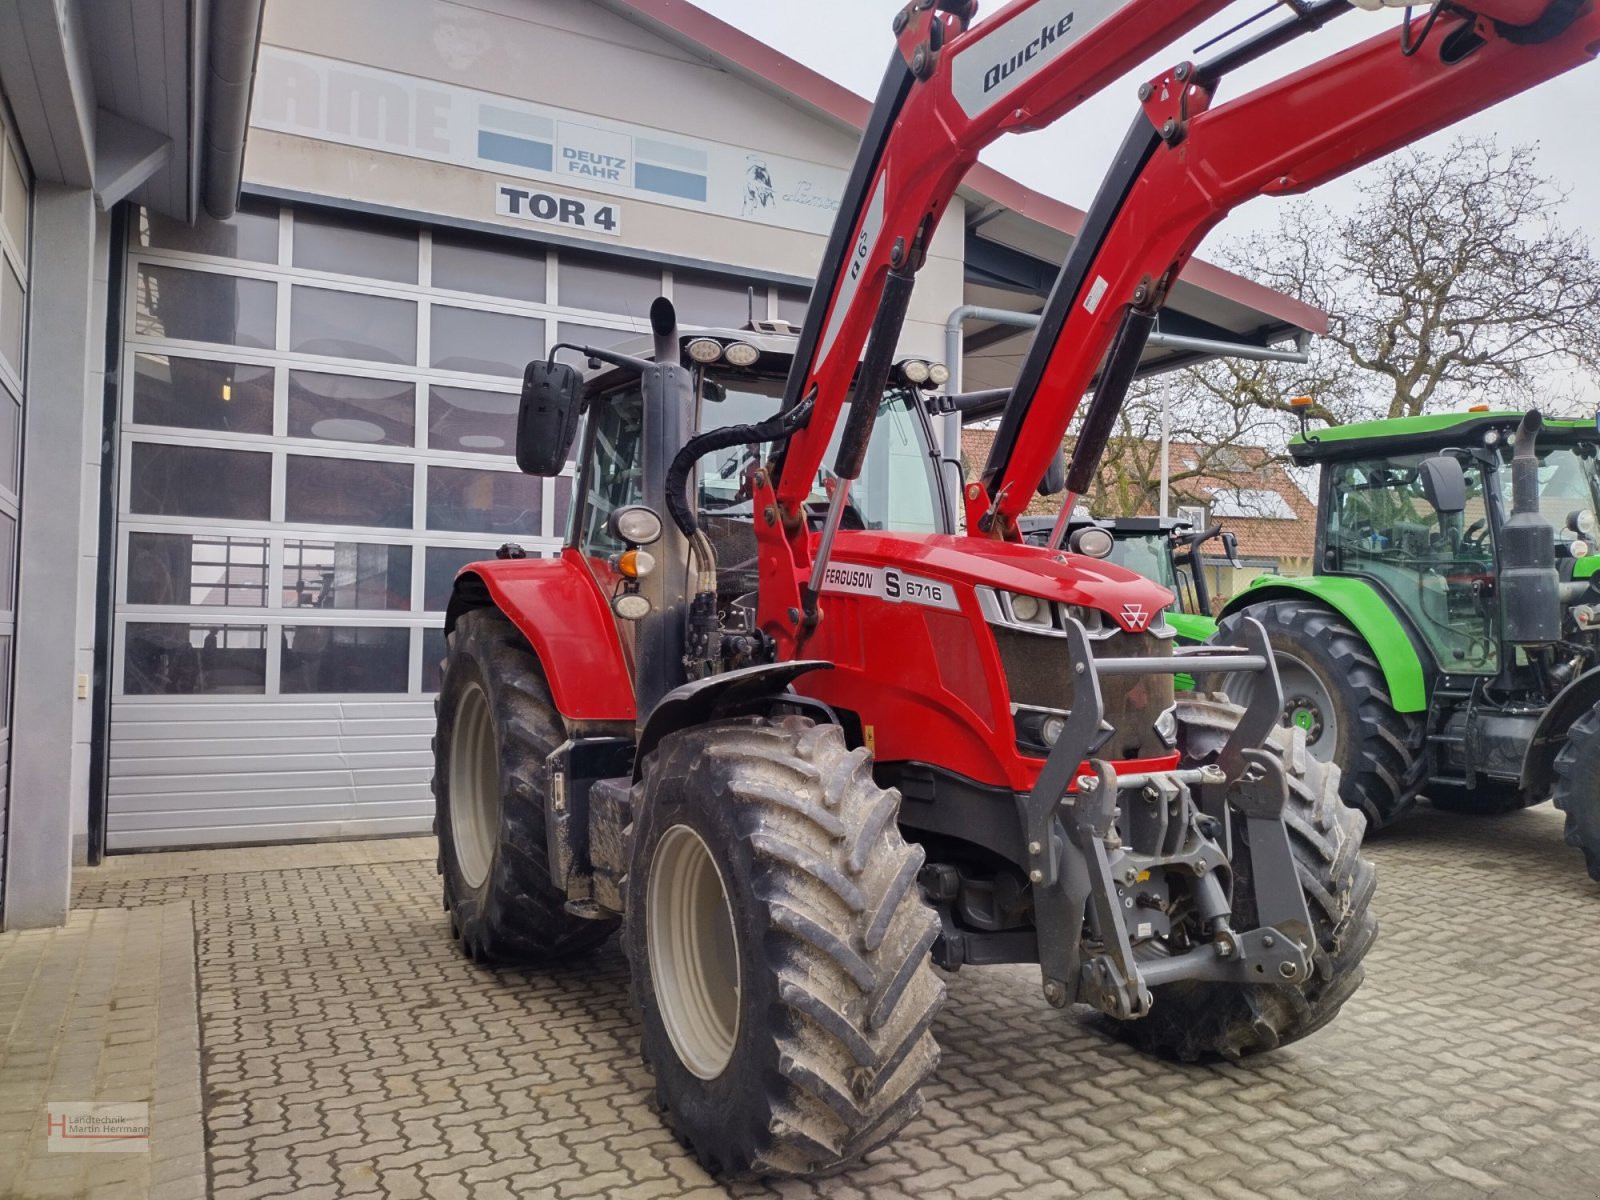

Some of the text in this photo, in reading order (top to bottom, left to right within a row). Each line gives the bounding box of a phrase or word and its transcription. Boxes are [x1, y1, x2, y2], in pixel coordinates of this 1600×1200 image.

[983, 11, 1074, 94] Quicke
[562, 147, 626, 170] DEUTZ
[568, 161, 620, 181] FAHR
[500, 186, 616, 231] TOR 4
[825, 568, 942, 601] FERGUSON S 6716
